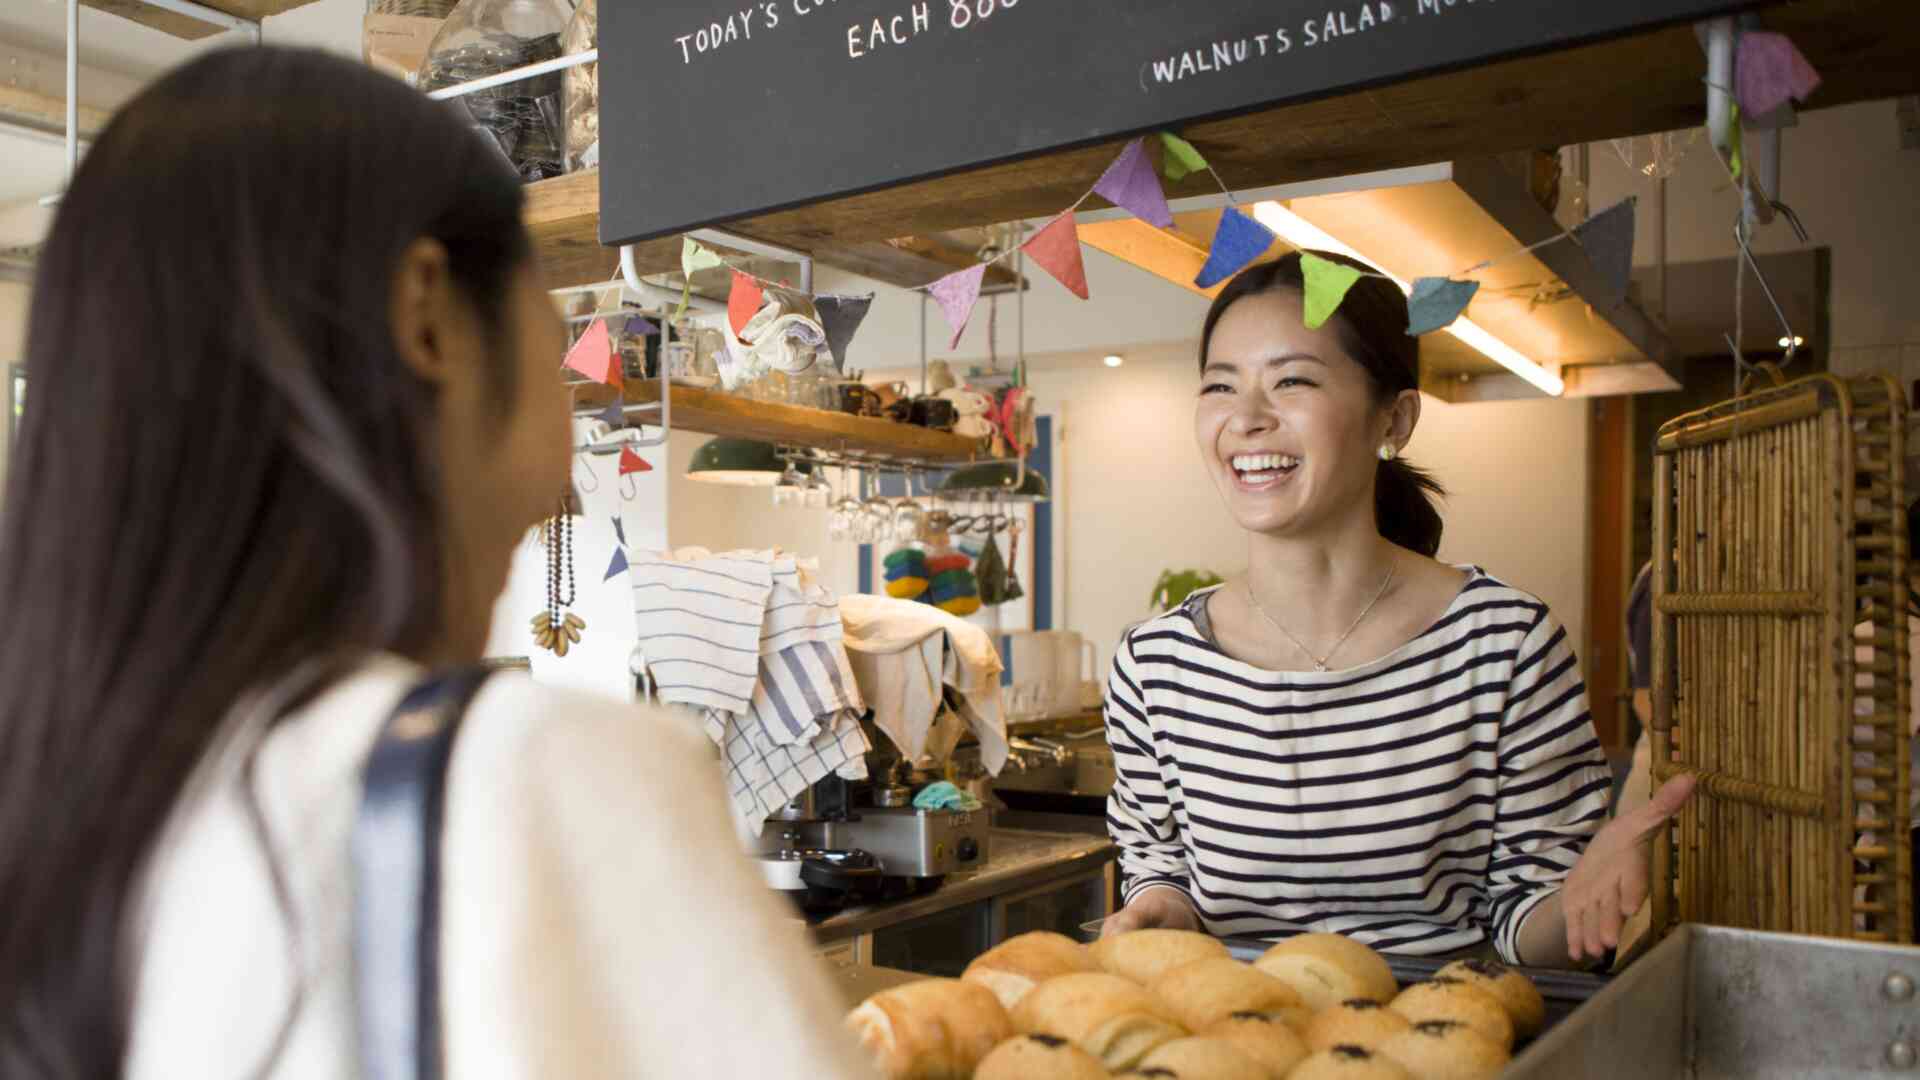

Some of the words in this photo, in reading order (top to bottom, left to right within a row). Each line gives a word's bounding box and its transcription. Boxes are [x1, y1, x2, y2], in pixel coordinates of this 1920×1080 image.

[674, 2, 779, 64] TODAY'S
[847, 2, 929, 58] EACH
[1303, 1, 1393, 46] SALAD
